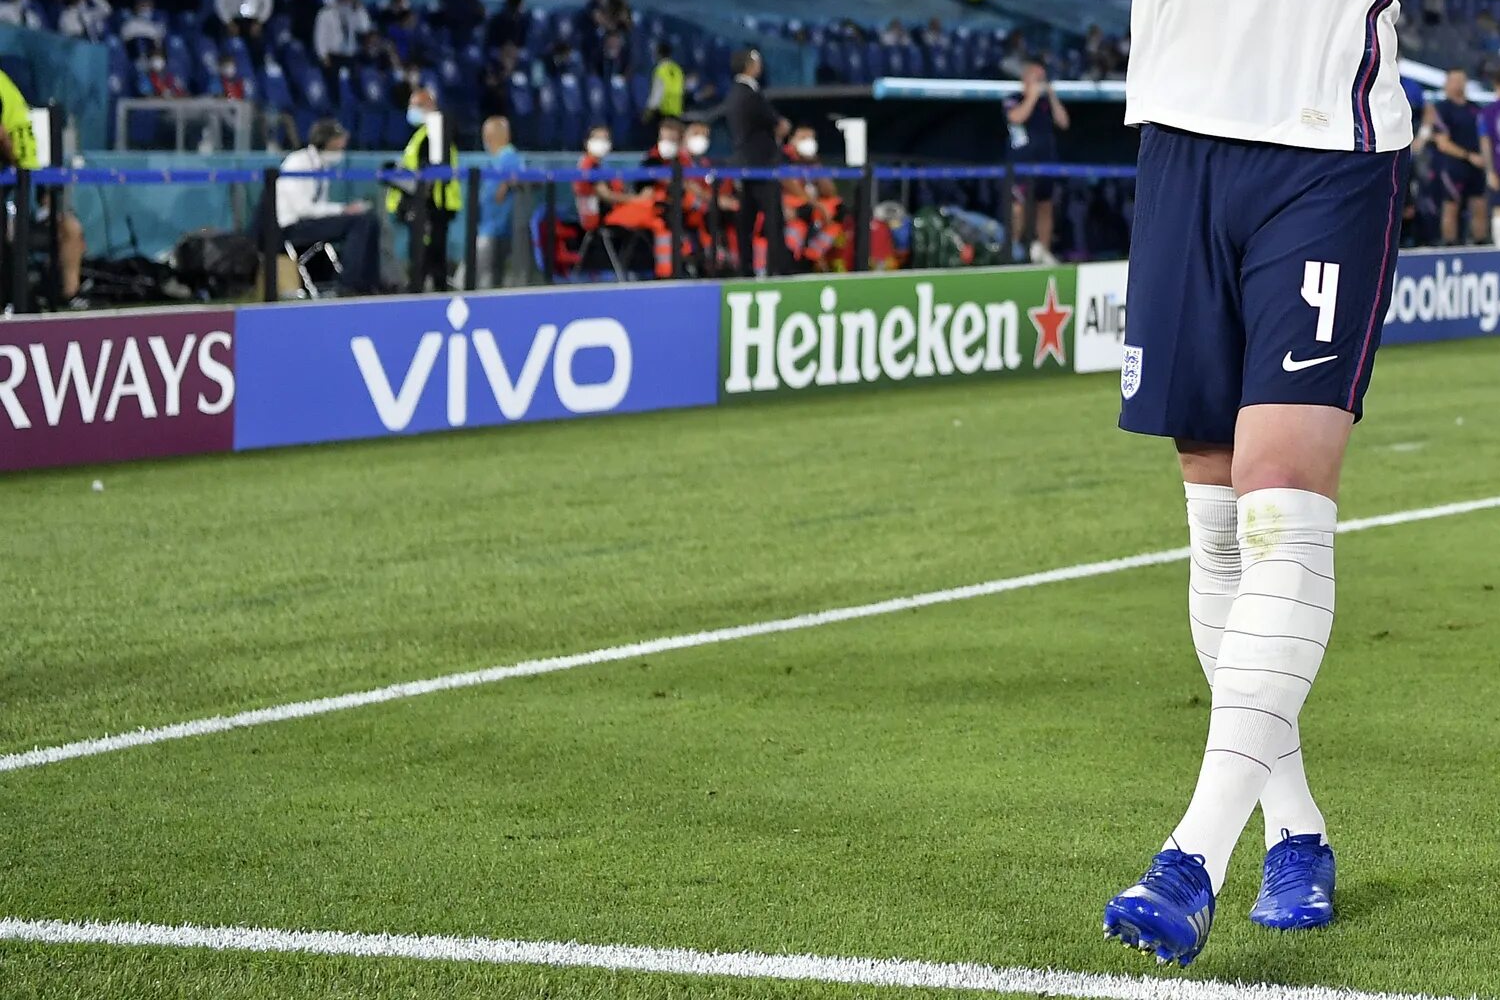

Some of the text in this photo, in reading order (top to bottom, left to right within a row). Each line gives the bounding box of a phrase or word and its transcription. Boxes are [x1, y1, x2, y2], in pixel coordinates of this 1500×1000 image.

[724, 282, 1023, 394] Heineken
[1300, 260, 1340, 343] 4
[0, 330, 236, 429] RWAYS
[350, 295, 634, 432] vivo
